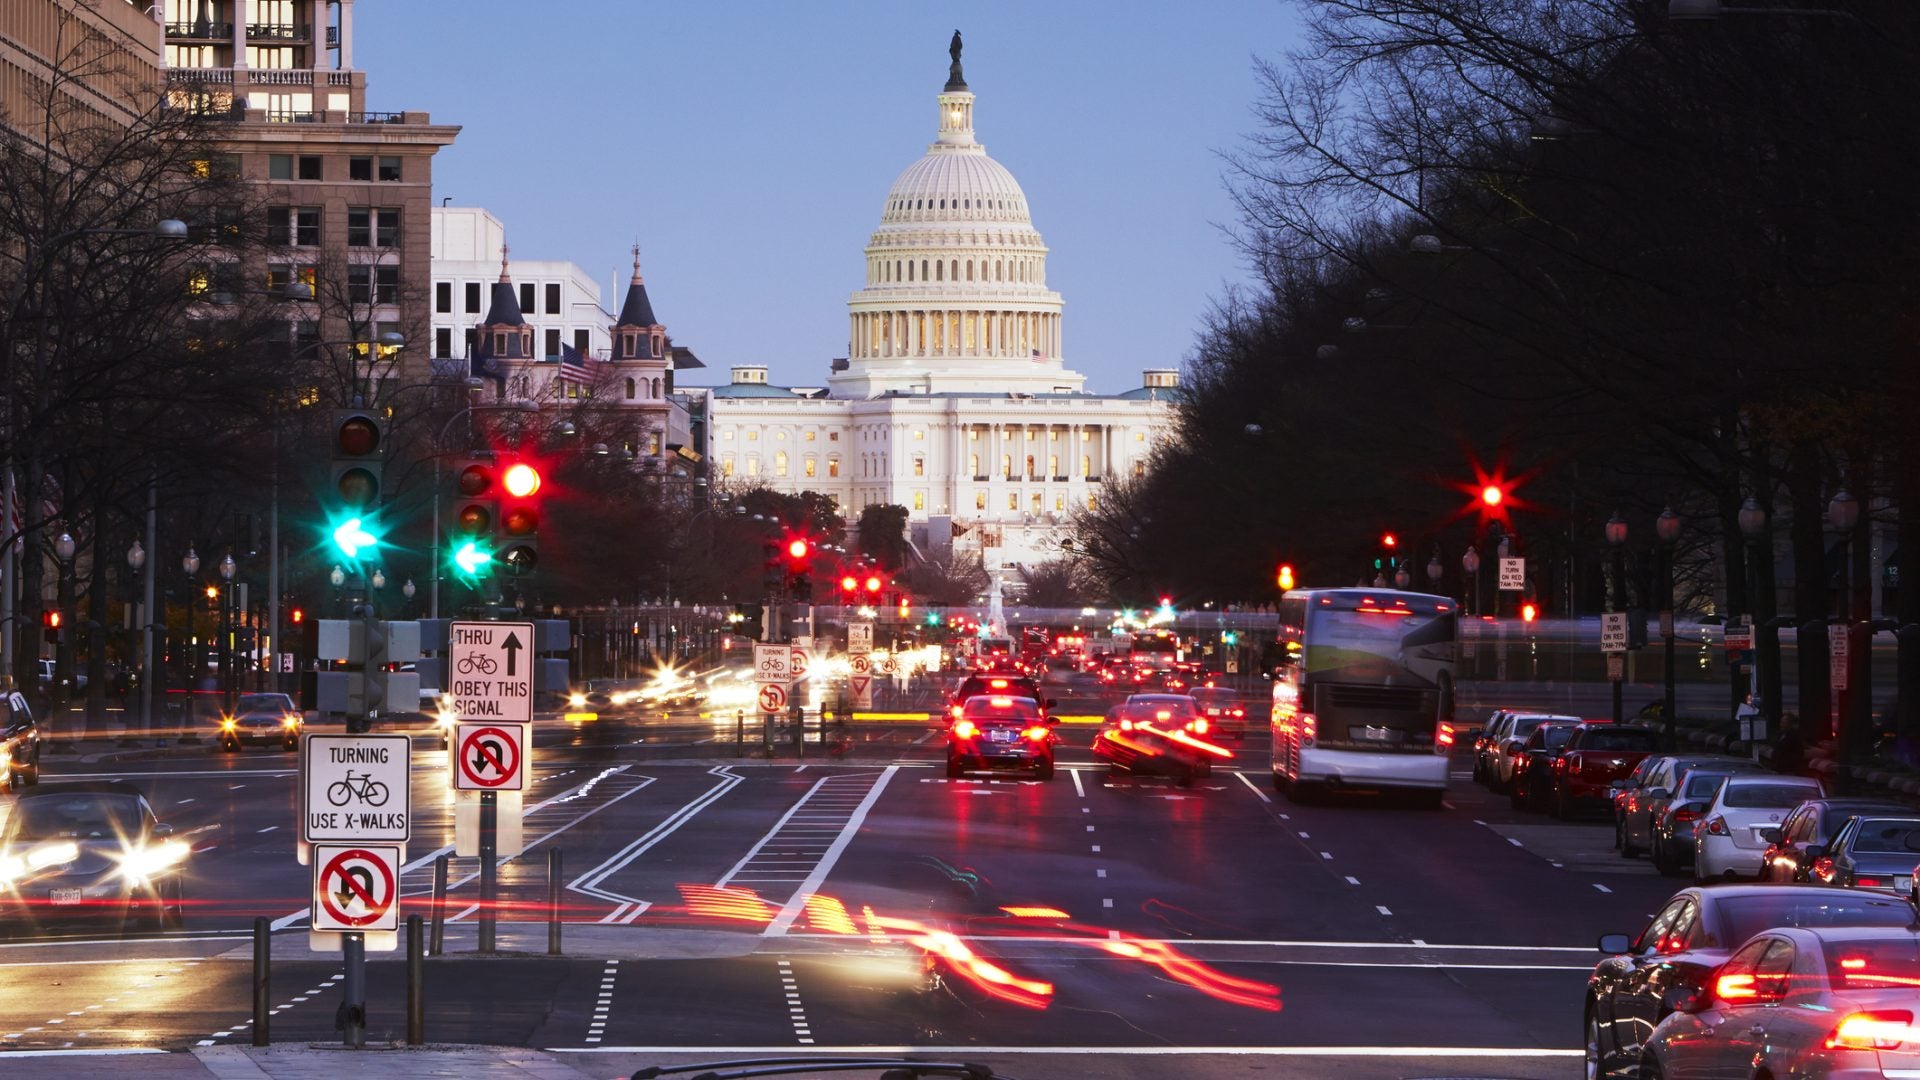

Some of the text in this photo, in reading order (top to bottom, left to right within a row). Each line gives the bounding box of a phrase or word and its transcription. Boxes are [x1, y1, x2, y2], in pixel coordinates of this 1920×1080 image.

[456, 629, 493, 645] THRU
[763, 648, 784, 656] TURNING
[454, 681, 528, 697] OBEY THIS
[454, 699, 503, 716] SIGNAL
[329, 747, 389, 764] TURNING
[310, 812, 405, 829] USE X-WALKS
